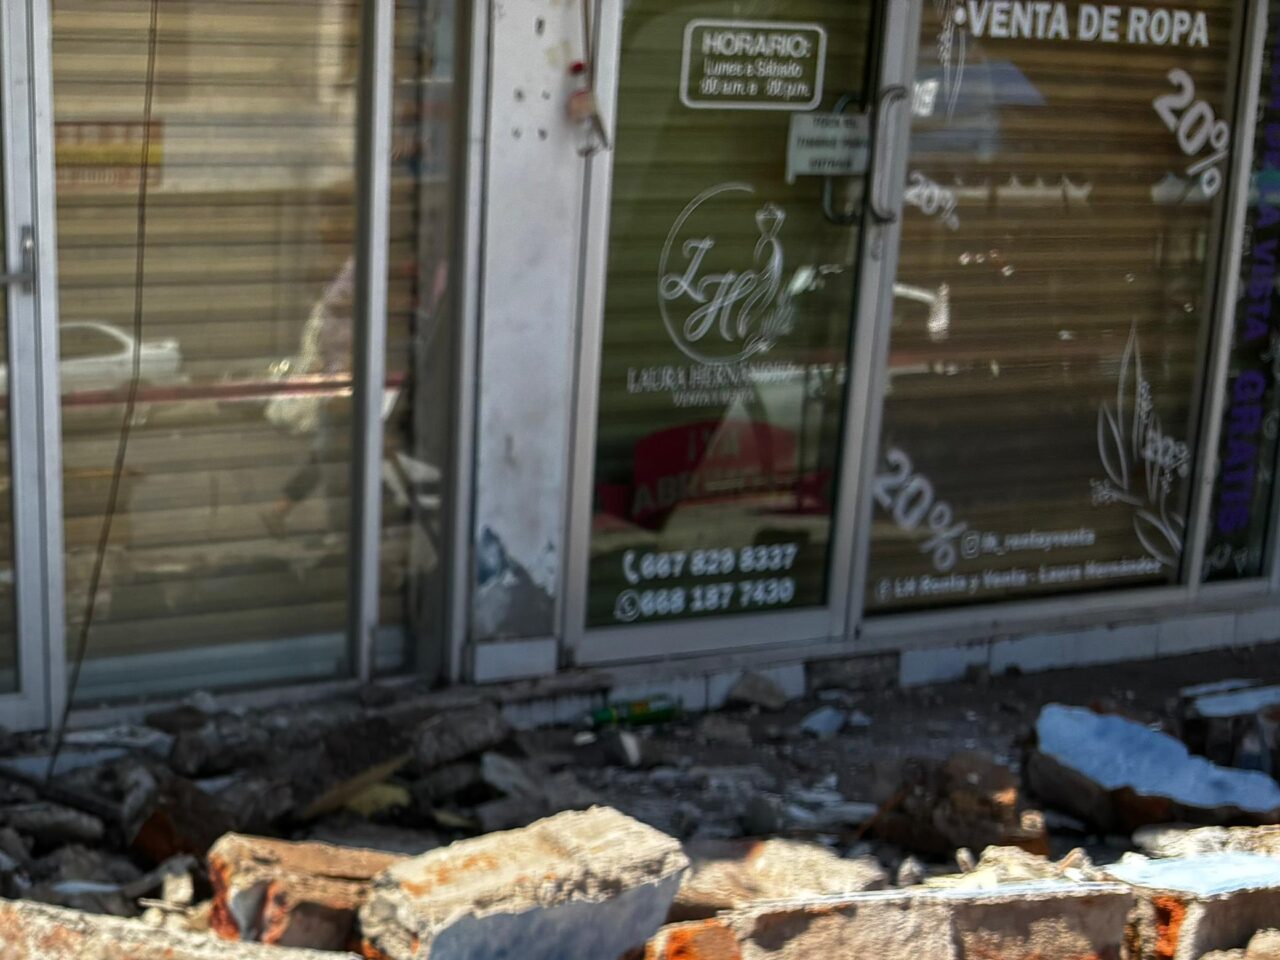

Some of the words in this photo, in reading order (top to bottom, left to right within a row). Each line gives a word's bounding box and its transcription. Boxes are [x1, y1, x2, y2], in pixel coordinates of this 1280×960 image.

[968, 1, 1069, 39] VENTA
[1078, 5, 1119, 42] DE
[1128, 8, 1209, 47] ROPA
[1154, 69, 1230, 197] 20%
[1243, 239, 1280, 341] VISTA
[1217, 369, 1267, 534] GRATIS
[640, 551, 687, 579] 667
[873, 448, 968, 570] 20%
